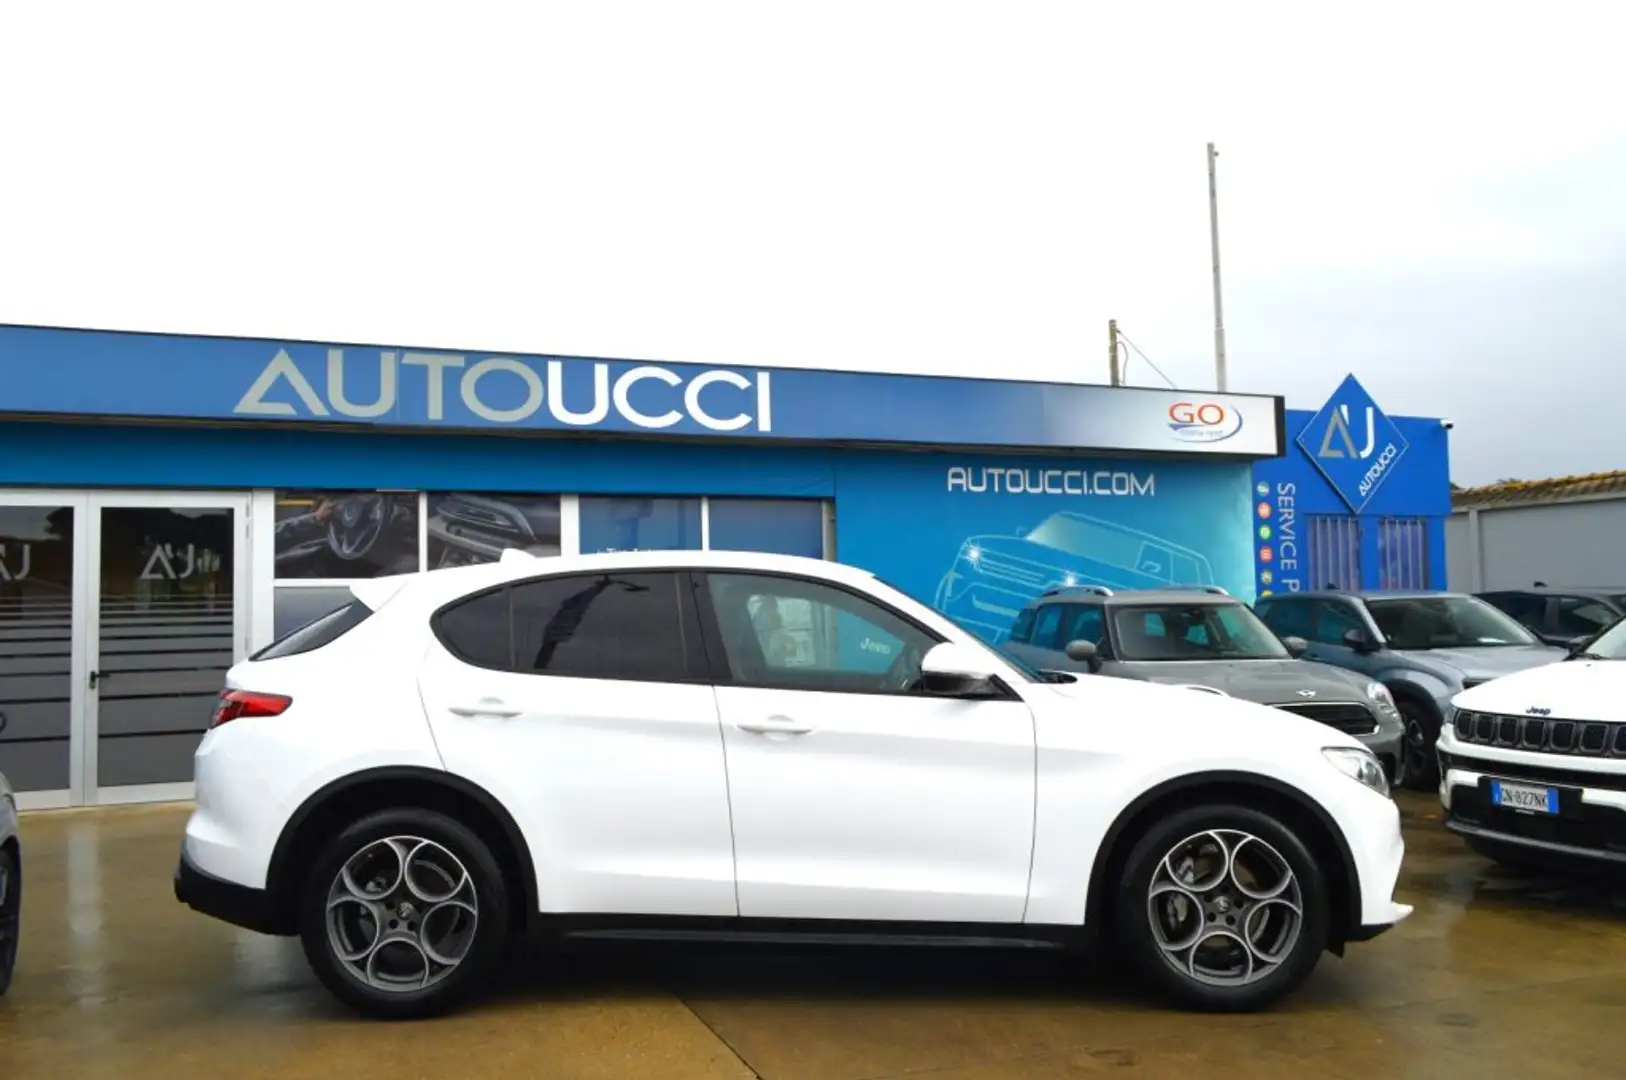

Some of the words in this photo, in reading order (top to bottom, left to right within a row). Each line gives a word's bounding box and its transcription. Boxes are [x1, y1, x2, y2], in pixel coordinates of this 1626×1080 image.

[233, 348, 771, 432] AUTOUCCI
[1169, 402, 1225, 425] GO
[947, 467, 1155, 496] AUTOUCCI.COM
[1277, 482, 1298, 570] SERVICE
